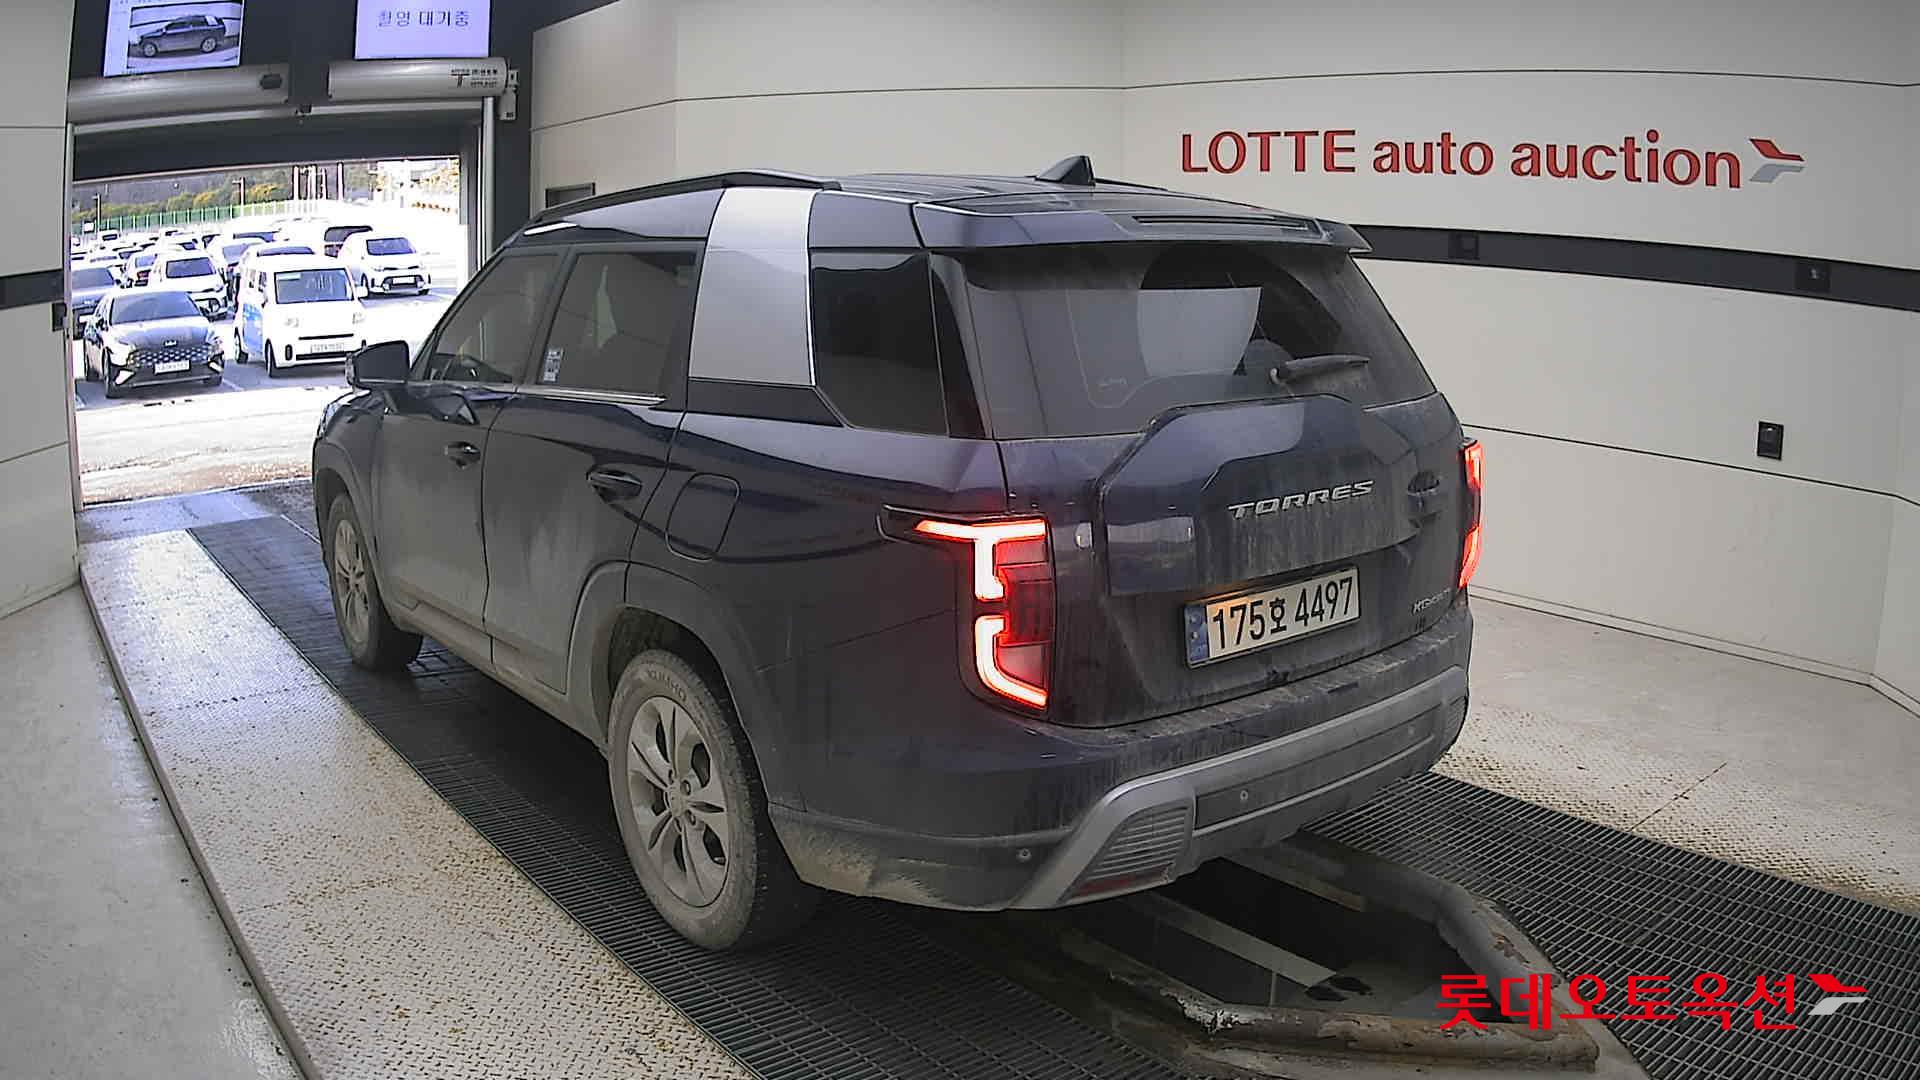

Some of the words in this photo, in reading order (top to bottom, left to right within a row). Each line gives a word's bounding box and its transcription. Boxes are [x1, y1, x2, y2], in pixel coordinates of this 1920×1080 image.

[419, 10, 469, 28] 대기중
[1182, 129, 1356, 175] LOTTE
[1372, 131, 1495, 176] auto
[1511, 128, 1742, 189] auction
[1227, 480, 1374, 519] TORRES
[1212, 597, 1287, 649] 175호
[1294, 576, 1353, 627] 4497
